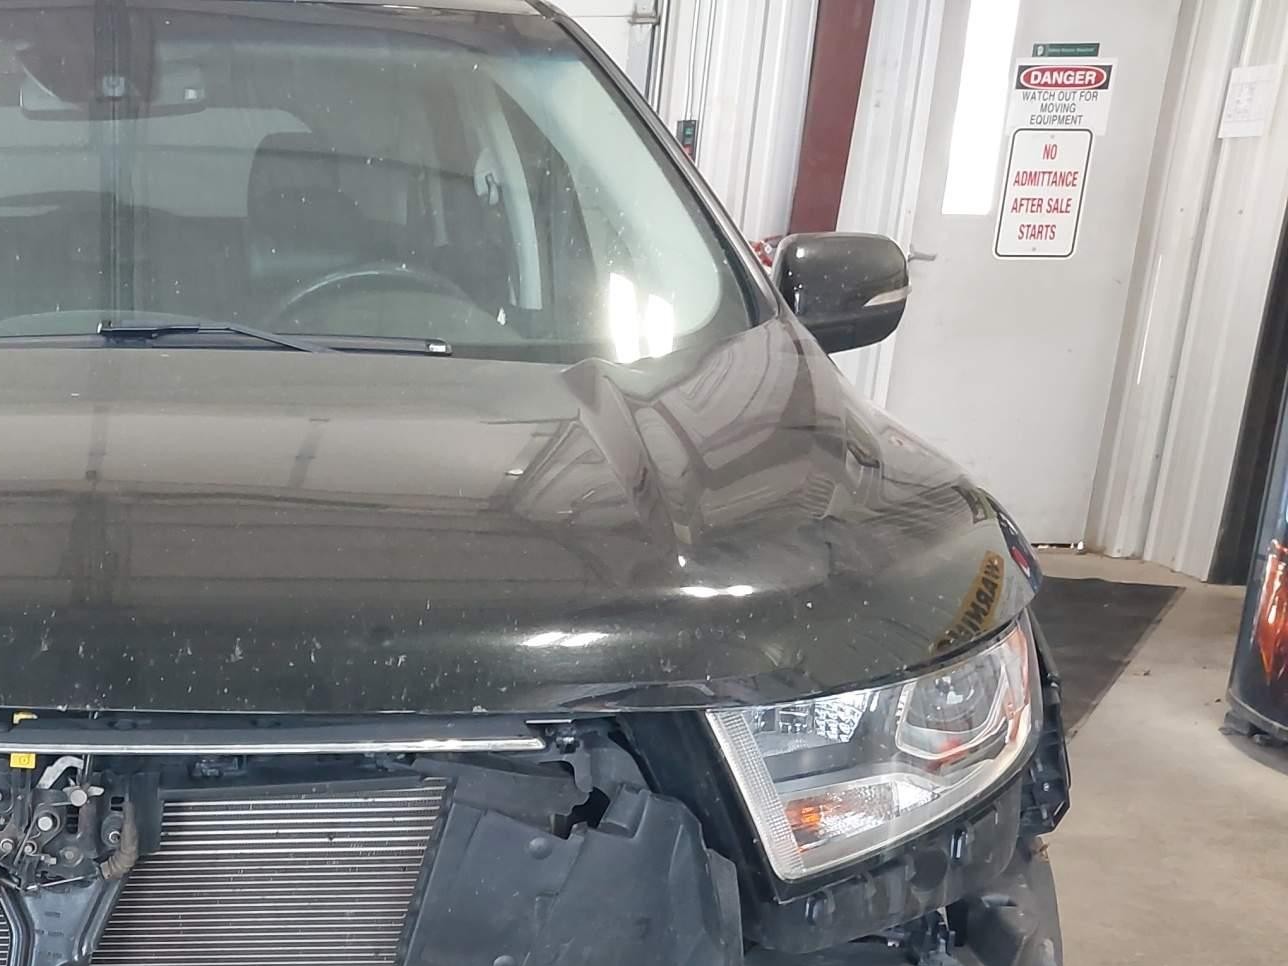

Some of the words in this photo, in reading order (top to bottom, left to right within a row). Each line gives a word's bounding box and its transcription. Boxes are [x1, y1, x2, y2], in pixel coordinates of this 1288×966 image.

[1030, 70, 1097, 85] DANGER
[1022, 90, 1056, 102] WATCH
[1058, 90, 1077, 102] OUT
[1079, 90, 1099, 102] FOR
[1040, 102, 1077, 114] MOVING
[1029, 114, 1083, 126] EQUIPMENT
[1042, 143, 1057, 160] NO
[1013, 171, 1079, 187] ADMITTANCE
[1011, 198, 1043, 214] AFTER
[1045, 198, 1072, 214] SALE
[1017, 224, 1057, 240] STARTS
